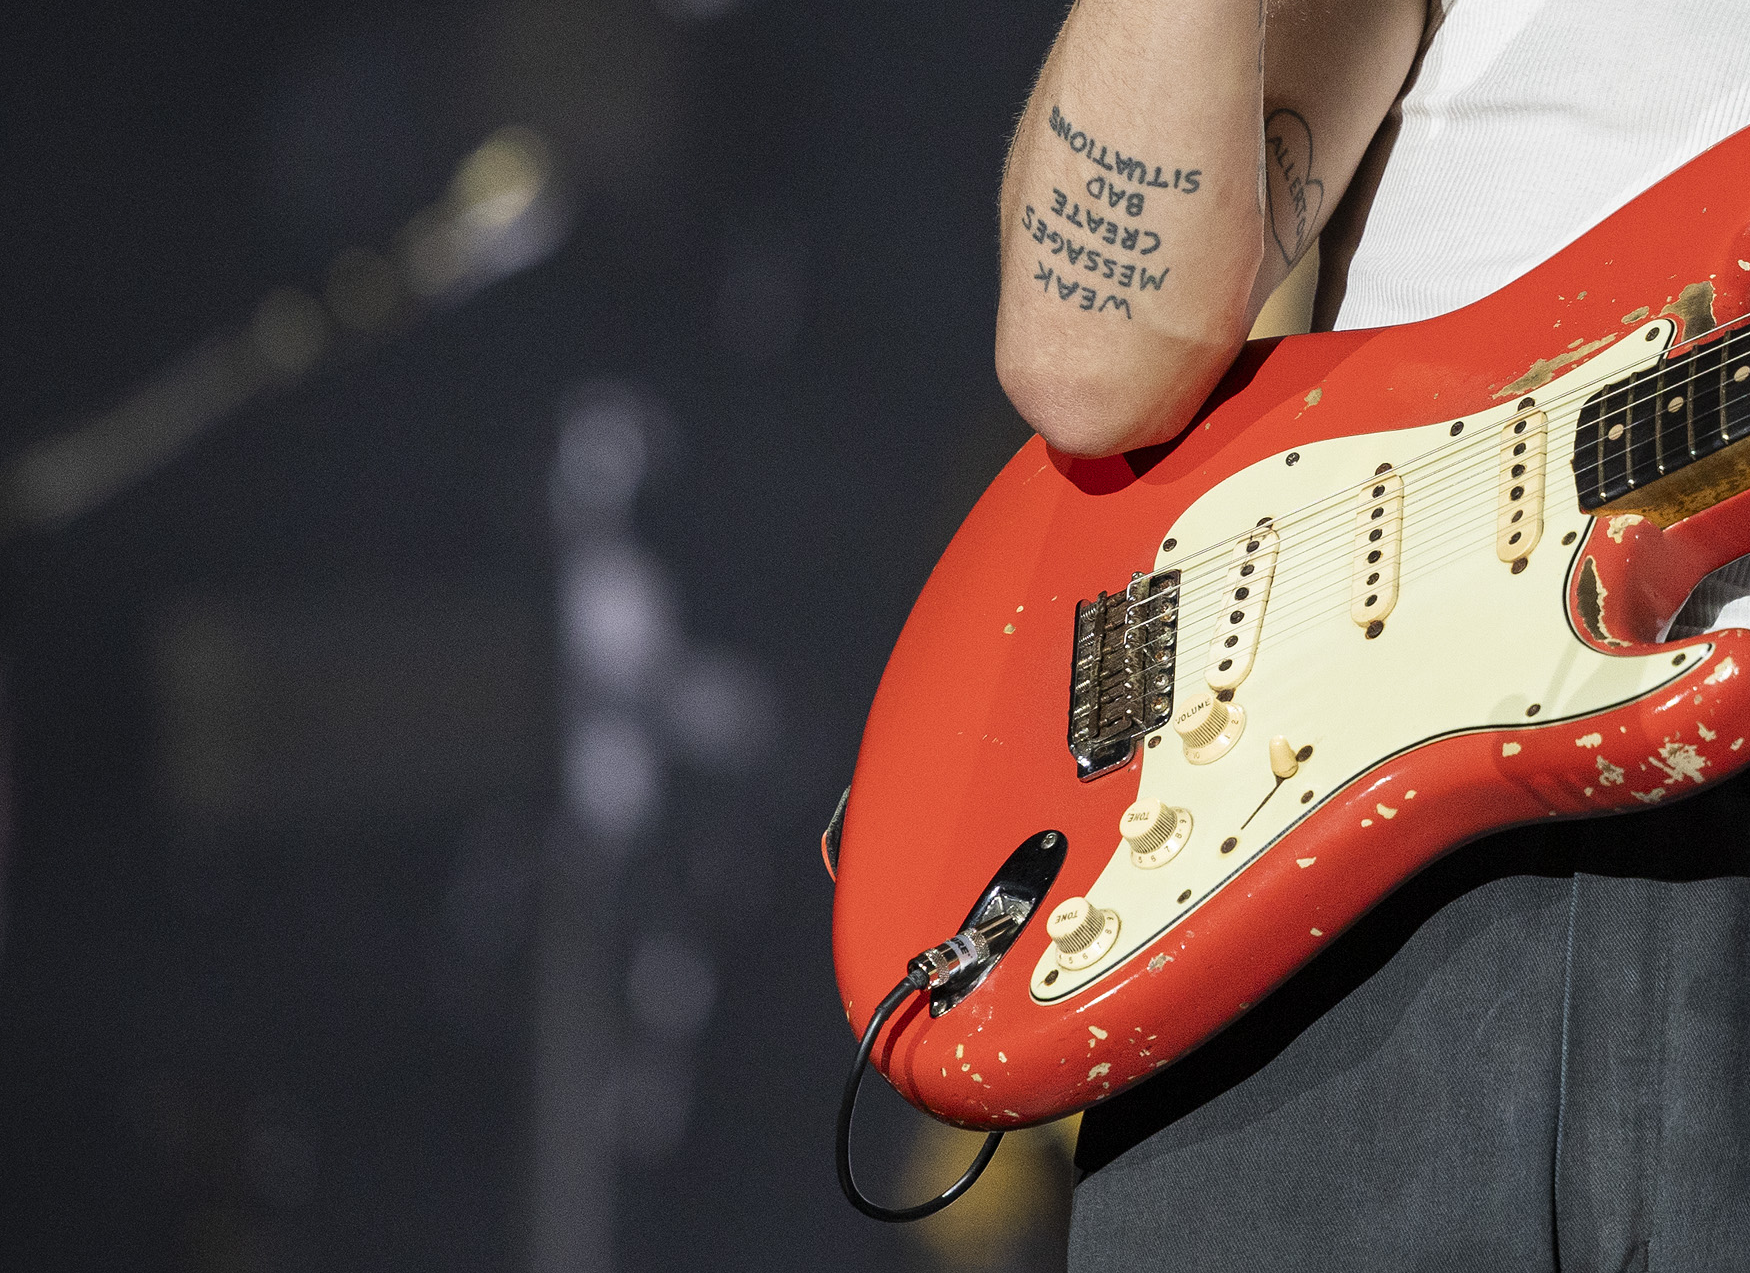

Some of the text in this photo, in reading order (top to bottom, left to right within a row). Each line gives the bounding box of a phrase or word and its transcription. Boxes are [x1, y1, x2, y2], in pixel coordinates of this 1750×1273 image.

[1048, 105, 1202, 194] SITUATIONS
[1050, 187, 1162, 256] CREATE
[1086, 174, 1145, 218] BAD
[1022, 204, 1170, 292] MESSAGES
[1034, 260, 1132, 320] WEAK
[1175, 697, 1211, 725] VOLUME
[1127, 811, 1150, 823] TONE
[1055, 910, 1078, 924] TONE
